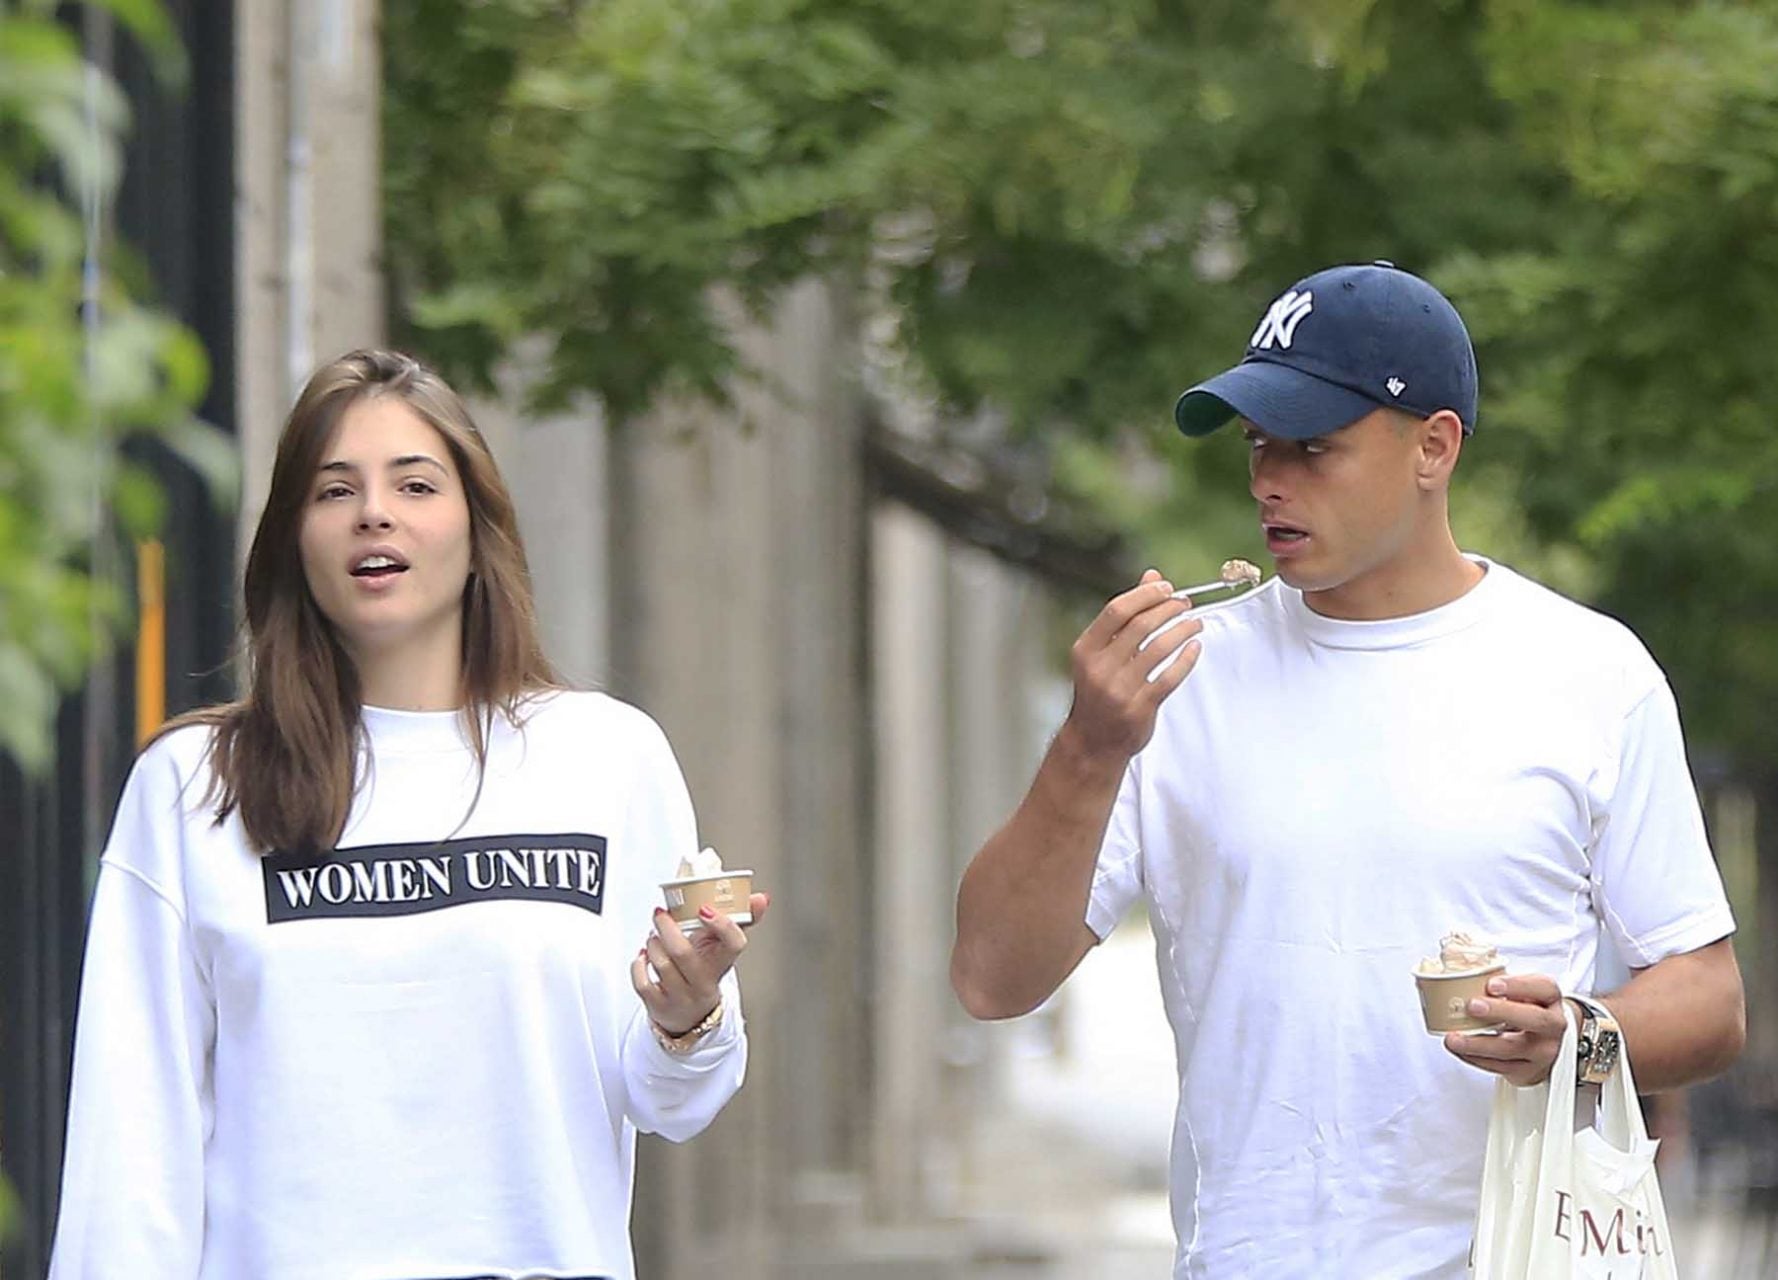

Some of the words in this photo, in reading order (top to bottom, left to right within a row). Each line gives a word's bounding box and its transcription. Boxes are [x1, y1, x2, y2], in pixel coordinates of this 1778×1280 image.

[1250, 290, 1313, 349] NY
[276, 857, 451, 909] WOMEN
[462, 848, 601, 897] UNITE
